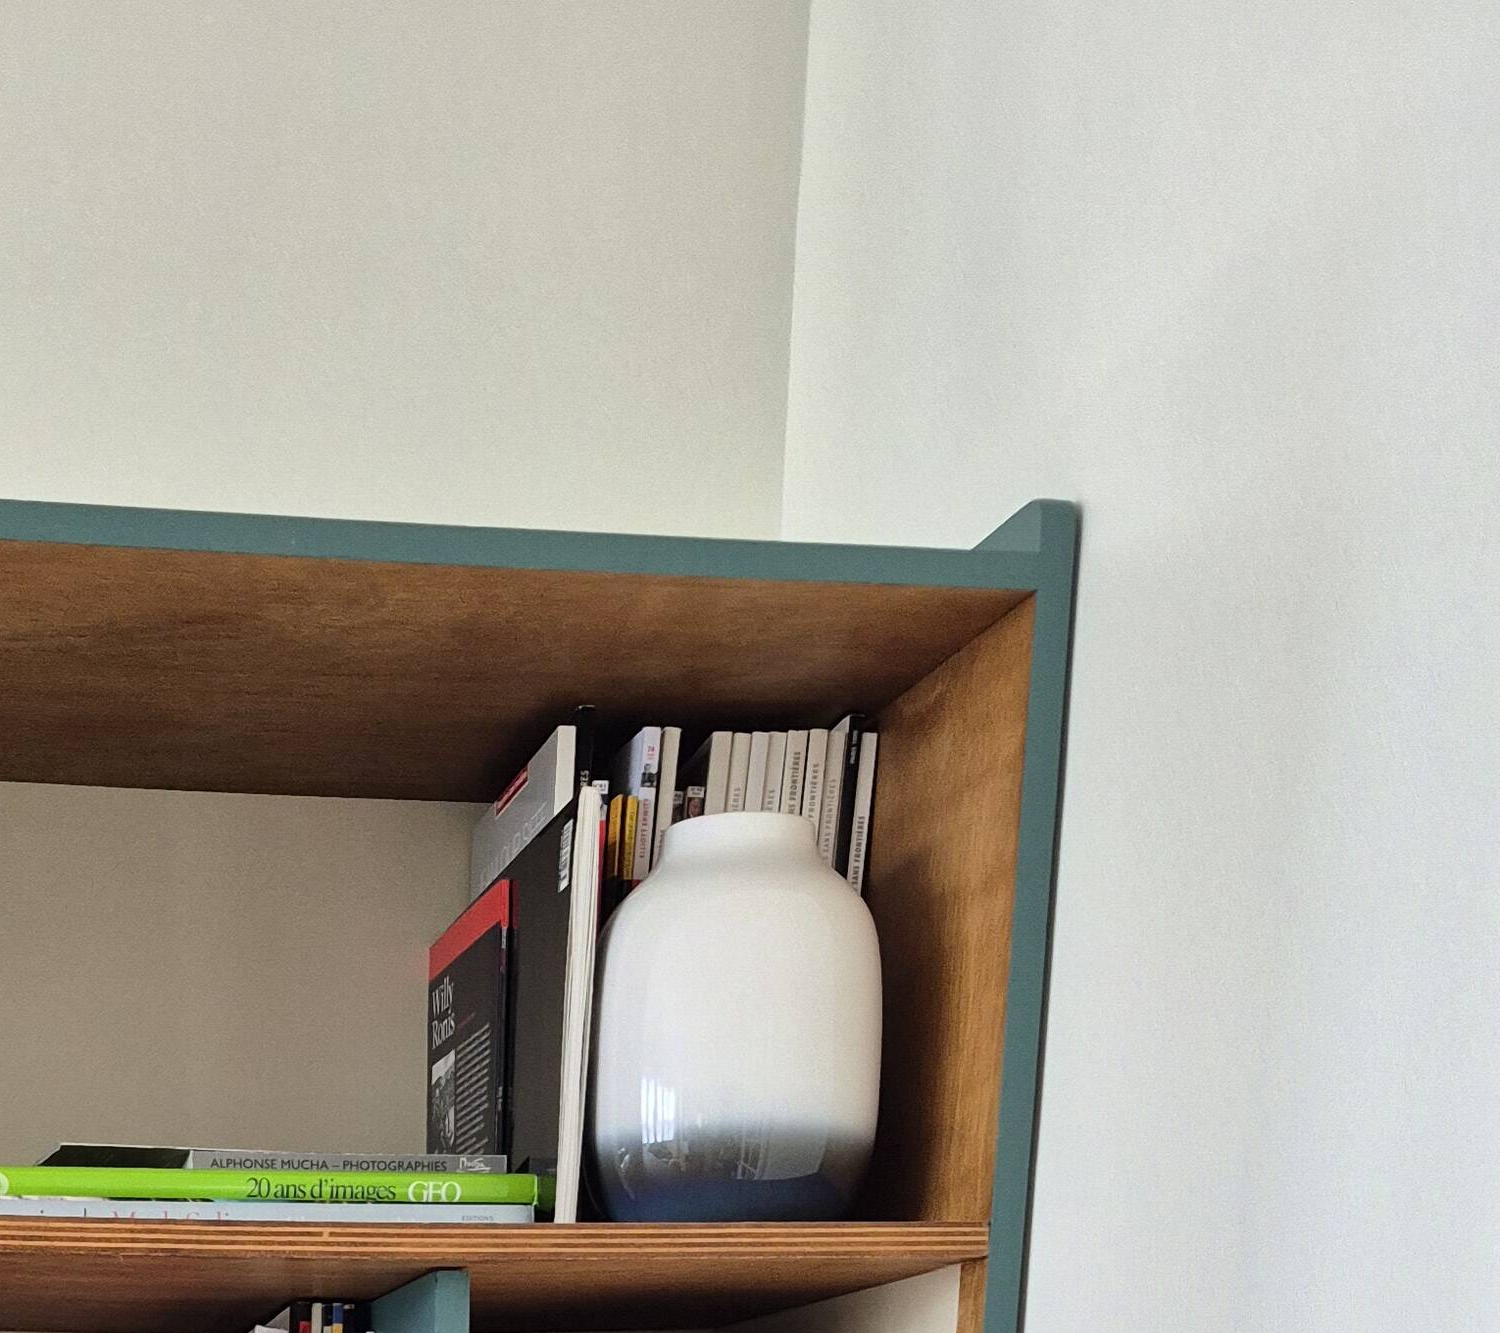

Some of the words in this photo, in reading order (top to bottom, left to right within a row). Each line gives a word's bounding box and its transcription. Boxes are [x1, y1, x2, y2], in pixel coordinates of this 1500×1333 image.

[788, 751, 801, 805] FRONTIÈRES
[807, 761, 820, 819] FRONTIÈRES
[822, 778, 837, 831] FRONTIÈRES
[852, 815, 867, 864] FRONTIÈRES
[431, 975, 454, 1017] Willy
[431, 1011, 456, 1051] Ronis
[209, 1158, 280, 1171] ALPHONSE
[280, 1159, 329, 1171] MUCHA
[342, 1159, 448, 1173] PHOTOGRAPHIES
[245, 1176, 271, 1199] 20
[273, 1183, 307, 1200] ans
[309, 1178, 397, 1201] d'images
[406, 1179, 462, 1203] GEO
